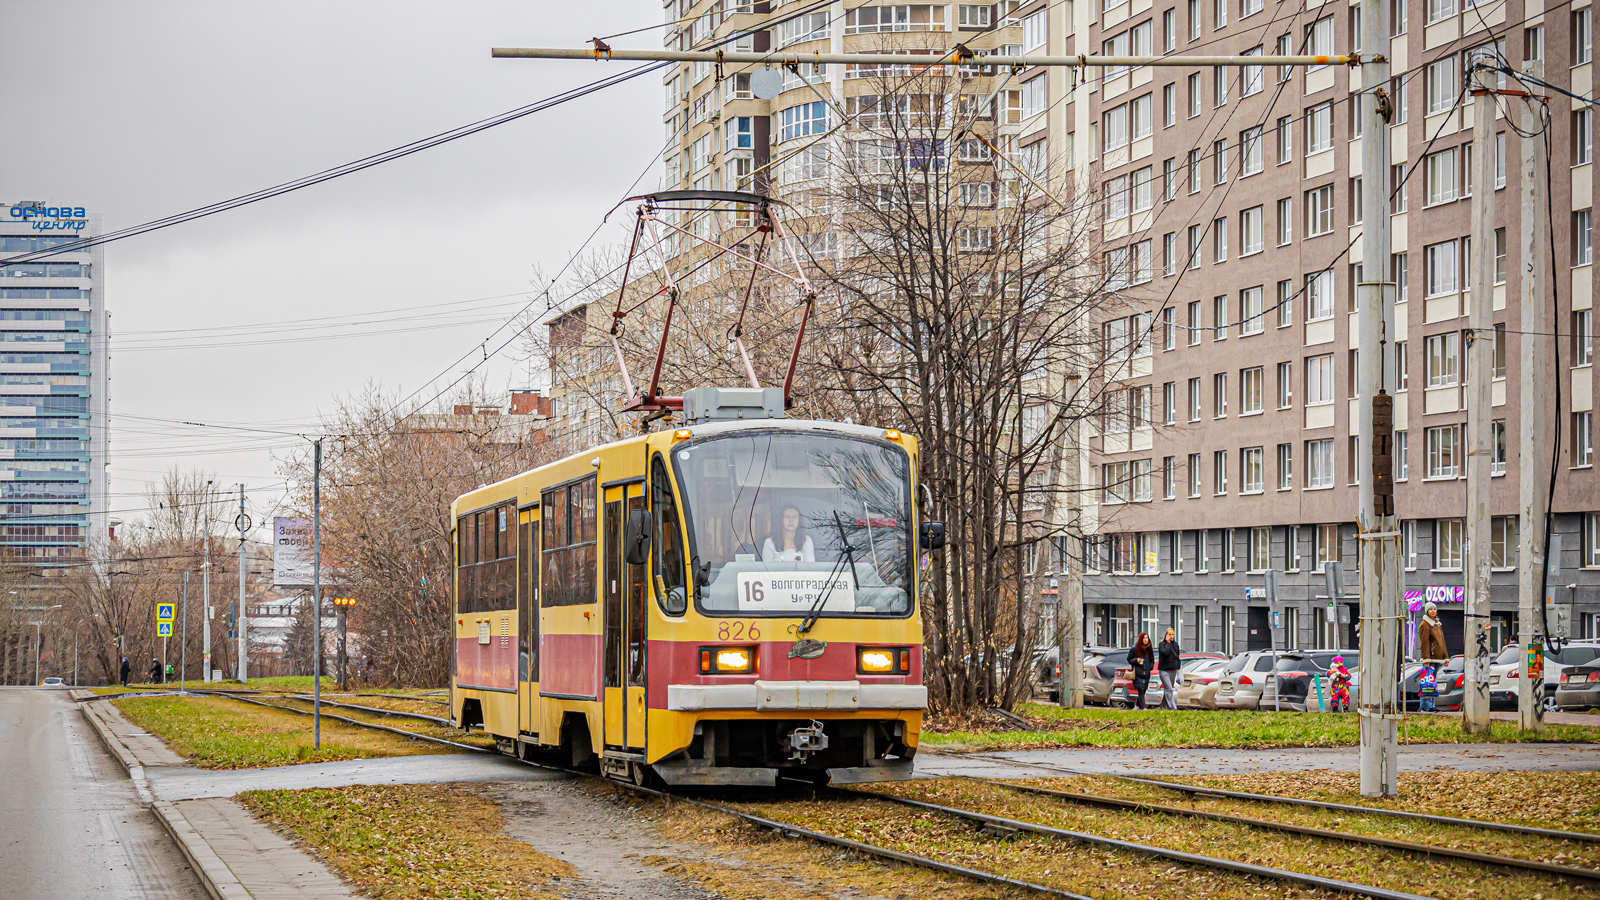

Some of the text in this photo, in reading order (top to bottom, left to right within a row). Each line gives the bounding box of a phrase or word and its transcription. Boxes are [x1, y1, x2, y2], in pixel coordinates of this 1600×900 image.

[32, 220, 86, 234] центр
[743, 580, 765, 602] 16
[1426, 586, 1454, 601] OZON
[718, 620, 761, 641] 826
